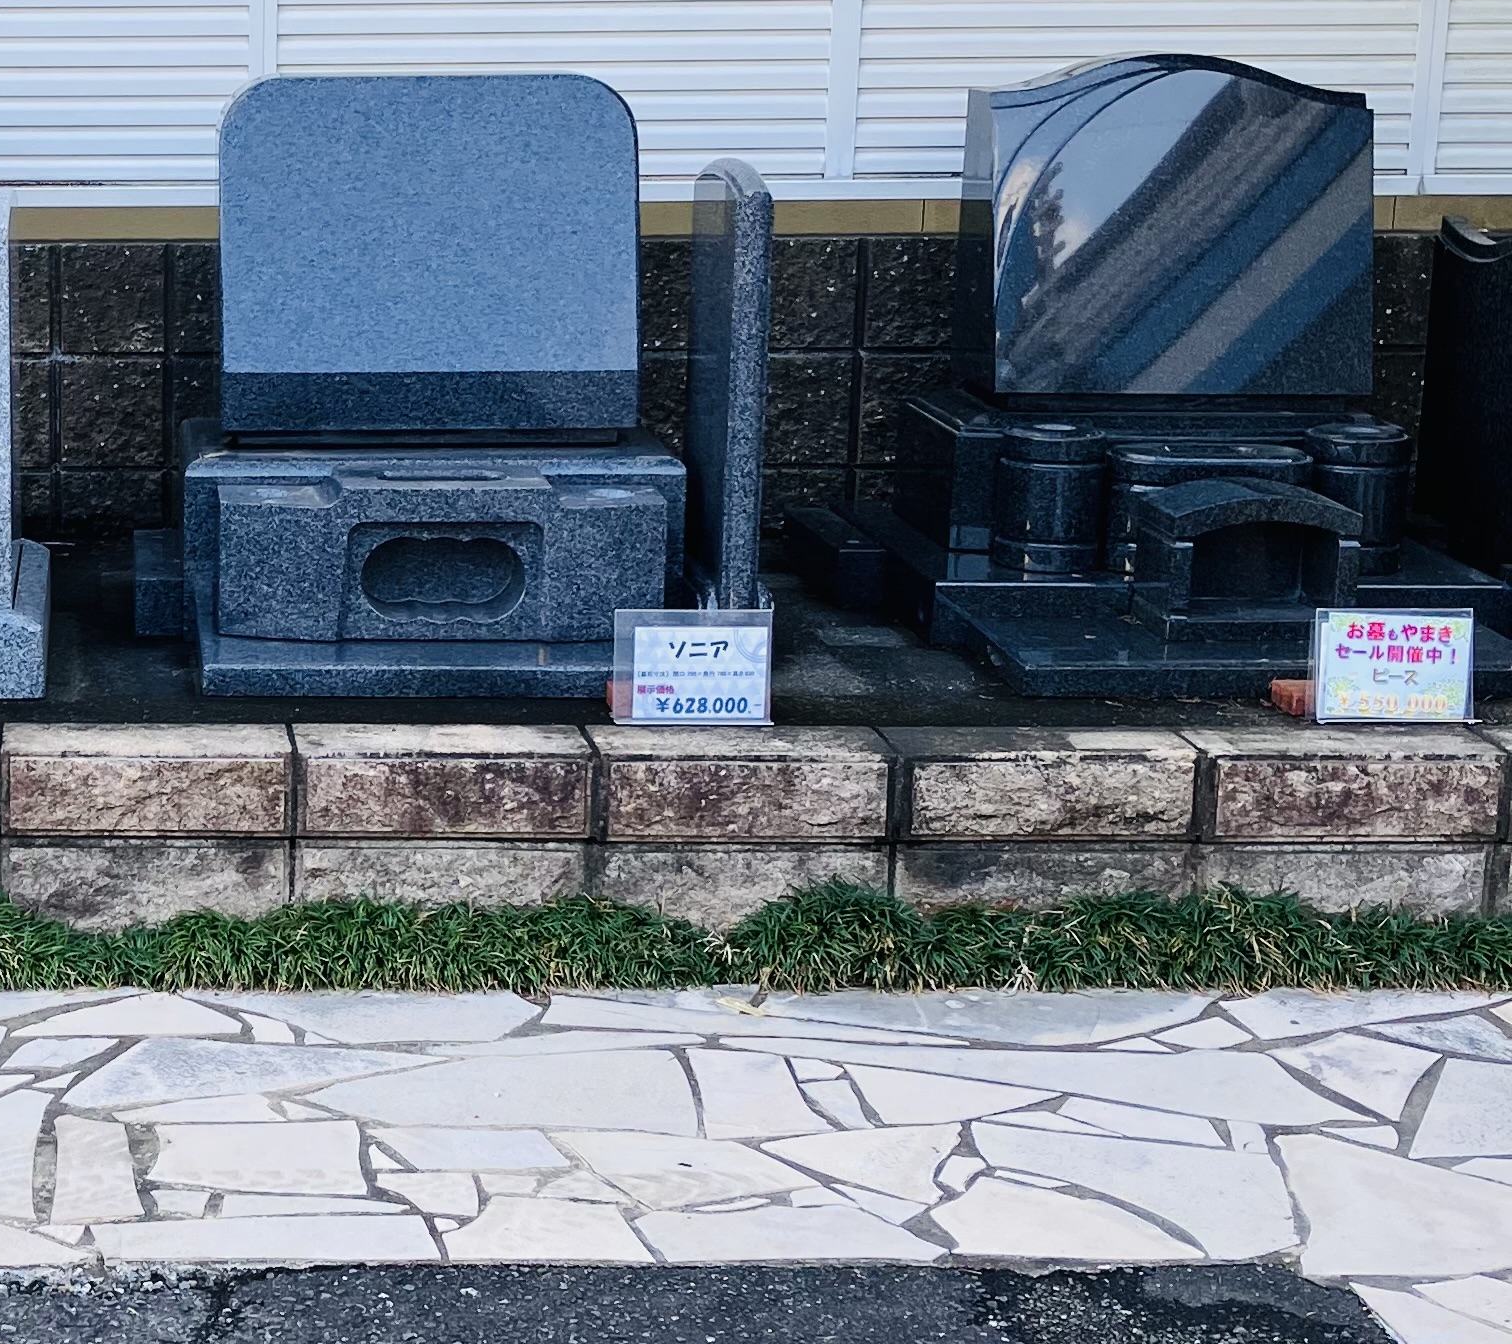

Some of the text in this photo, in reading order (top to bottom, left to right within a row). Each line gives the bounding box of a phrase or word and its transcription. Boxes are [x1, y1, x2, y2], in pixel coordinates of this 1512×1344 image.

[669, 641, 729, 659] ソニア
[1372, 668, 1419, 686] ピース
